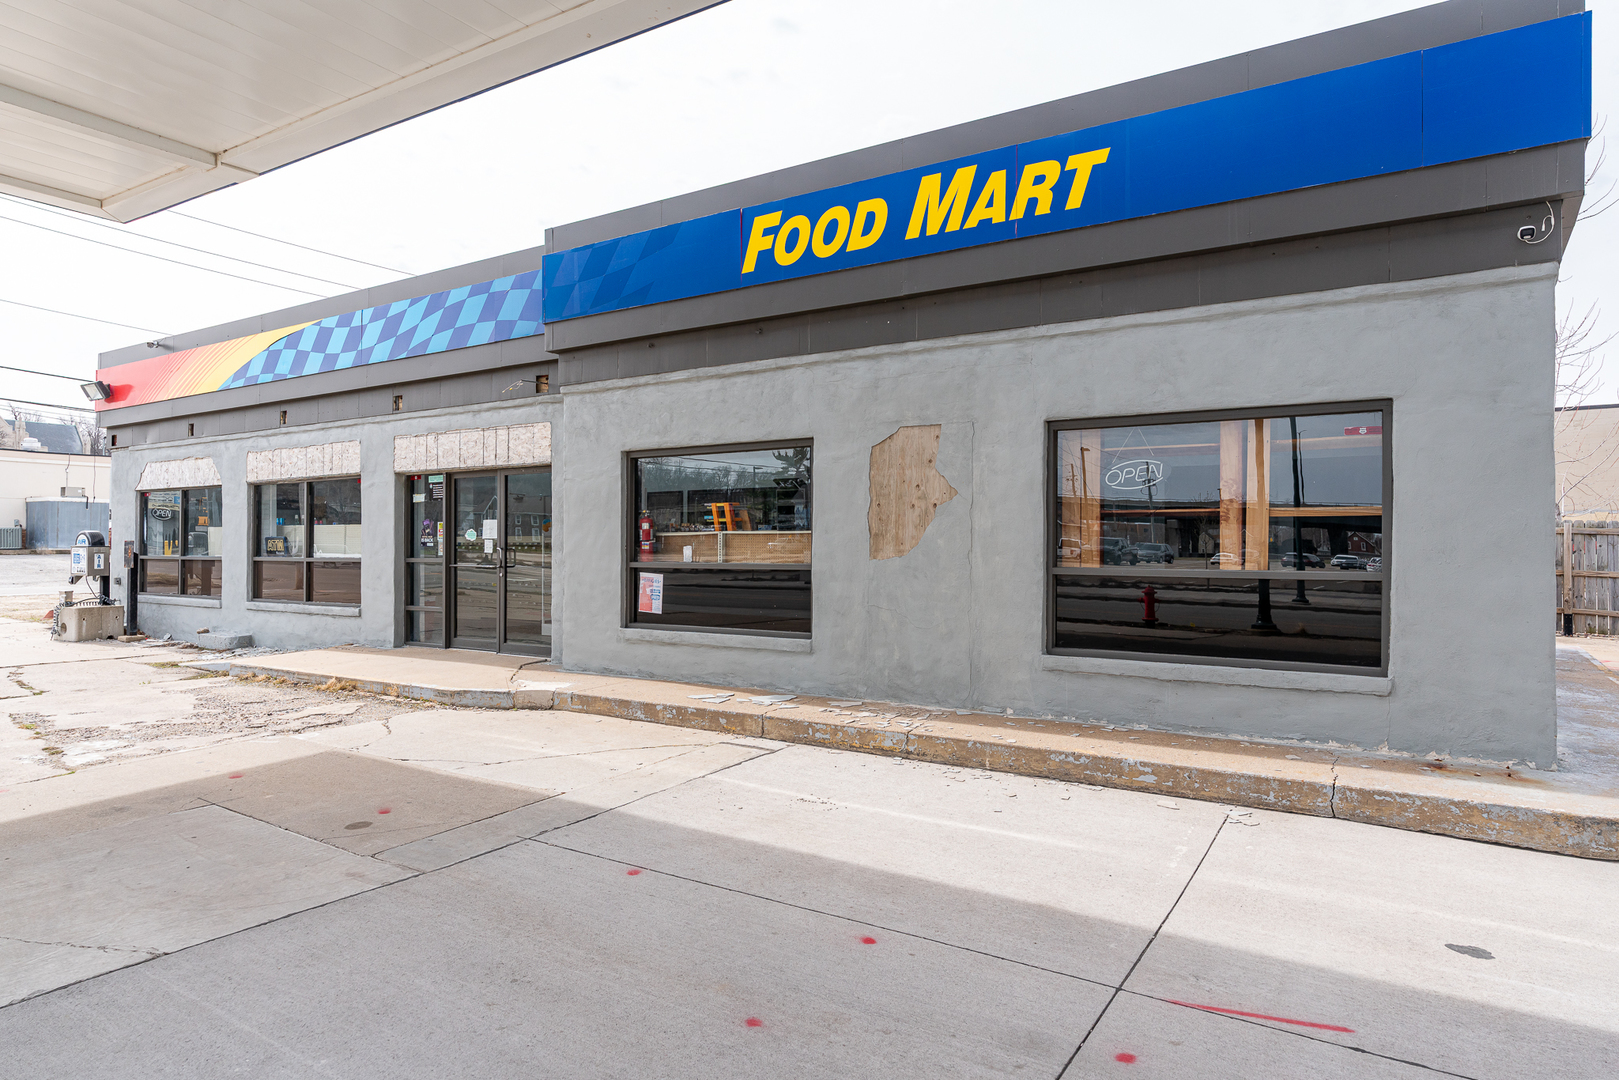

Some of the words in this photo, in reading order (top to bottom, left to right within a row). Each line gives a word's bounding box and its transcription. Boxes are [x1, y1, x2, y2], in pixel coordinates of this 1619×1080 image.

[741, 197, 888, 274] FOOD
[905, 146, 1111, 240] MART
[1105, 462, 1164, 487] OPEN
[152, 508, 172, 518] OPEN
